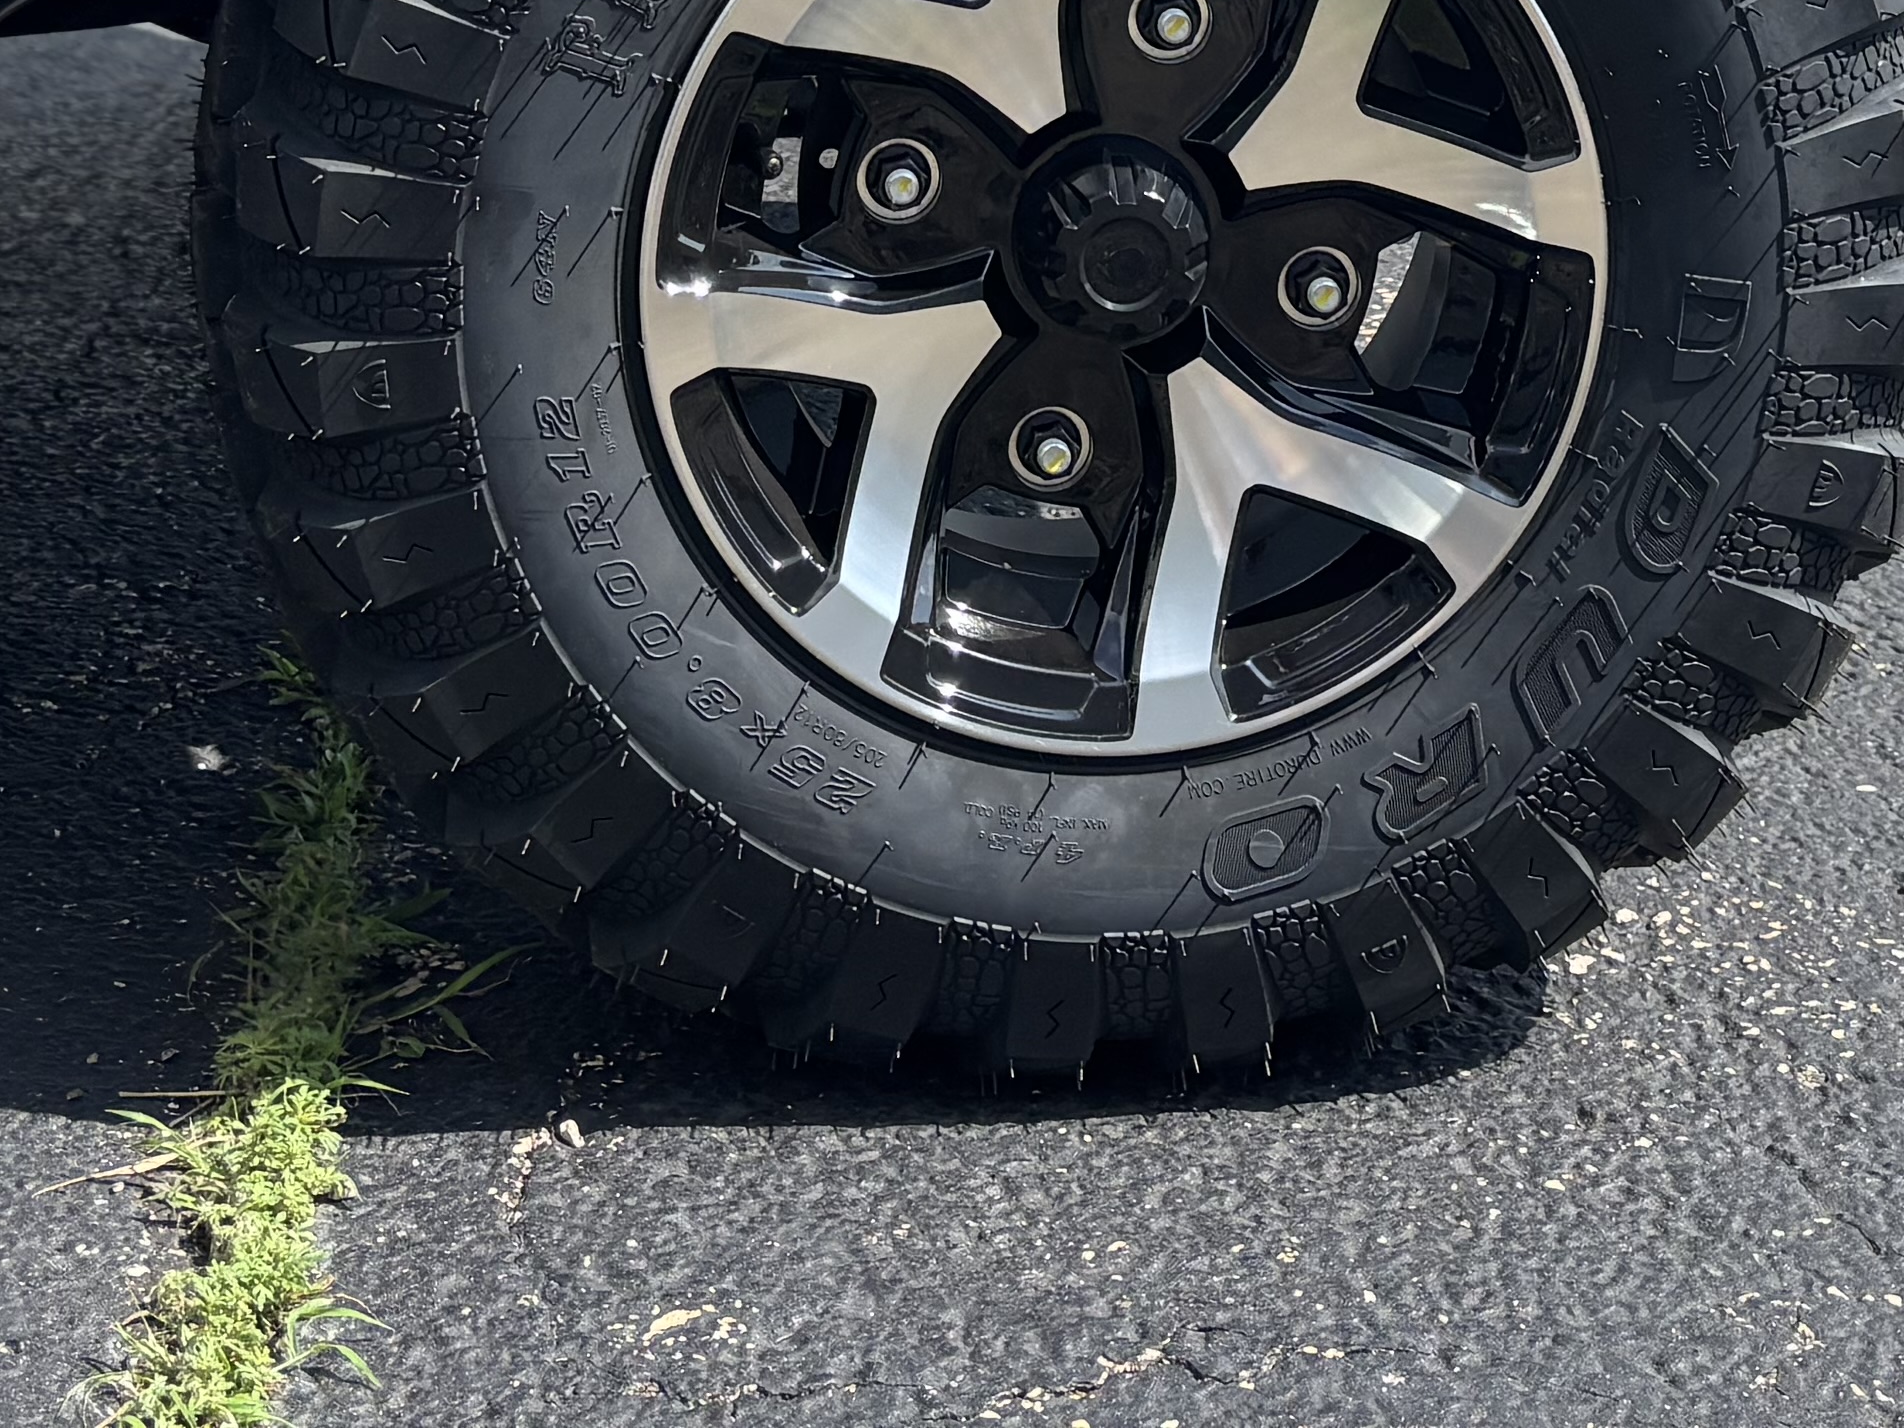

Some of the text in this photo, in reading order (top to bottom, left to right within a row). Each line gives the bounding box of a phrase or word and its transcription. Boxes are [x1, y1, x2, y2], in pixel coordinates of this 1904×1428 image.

[1545, 409, 1645, 582] Radial
[793, 702, 888, 770] 205/80R12
[1203, 423, 1720, 904] DURO
